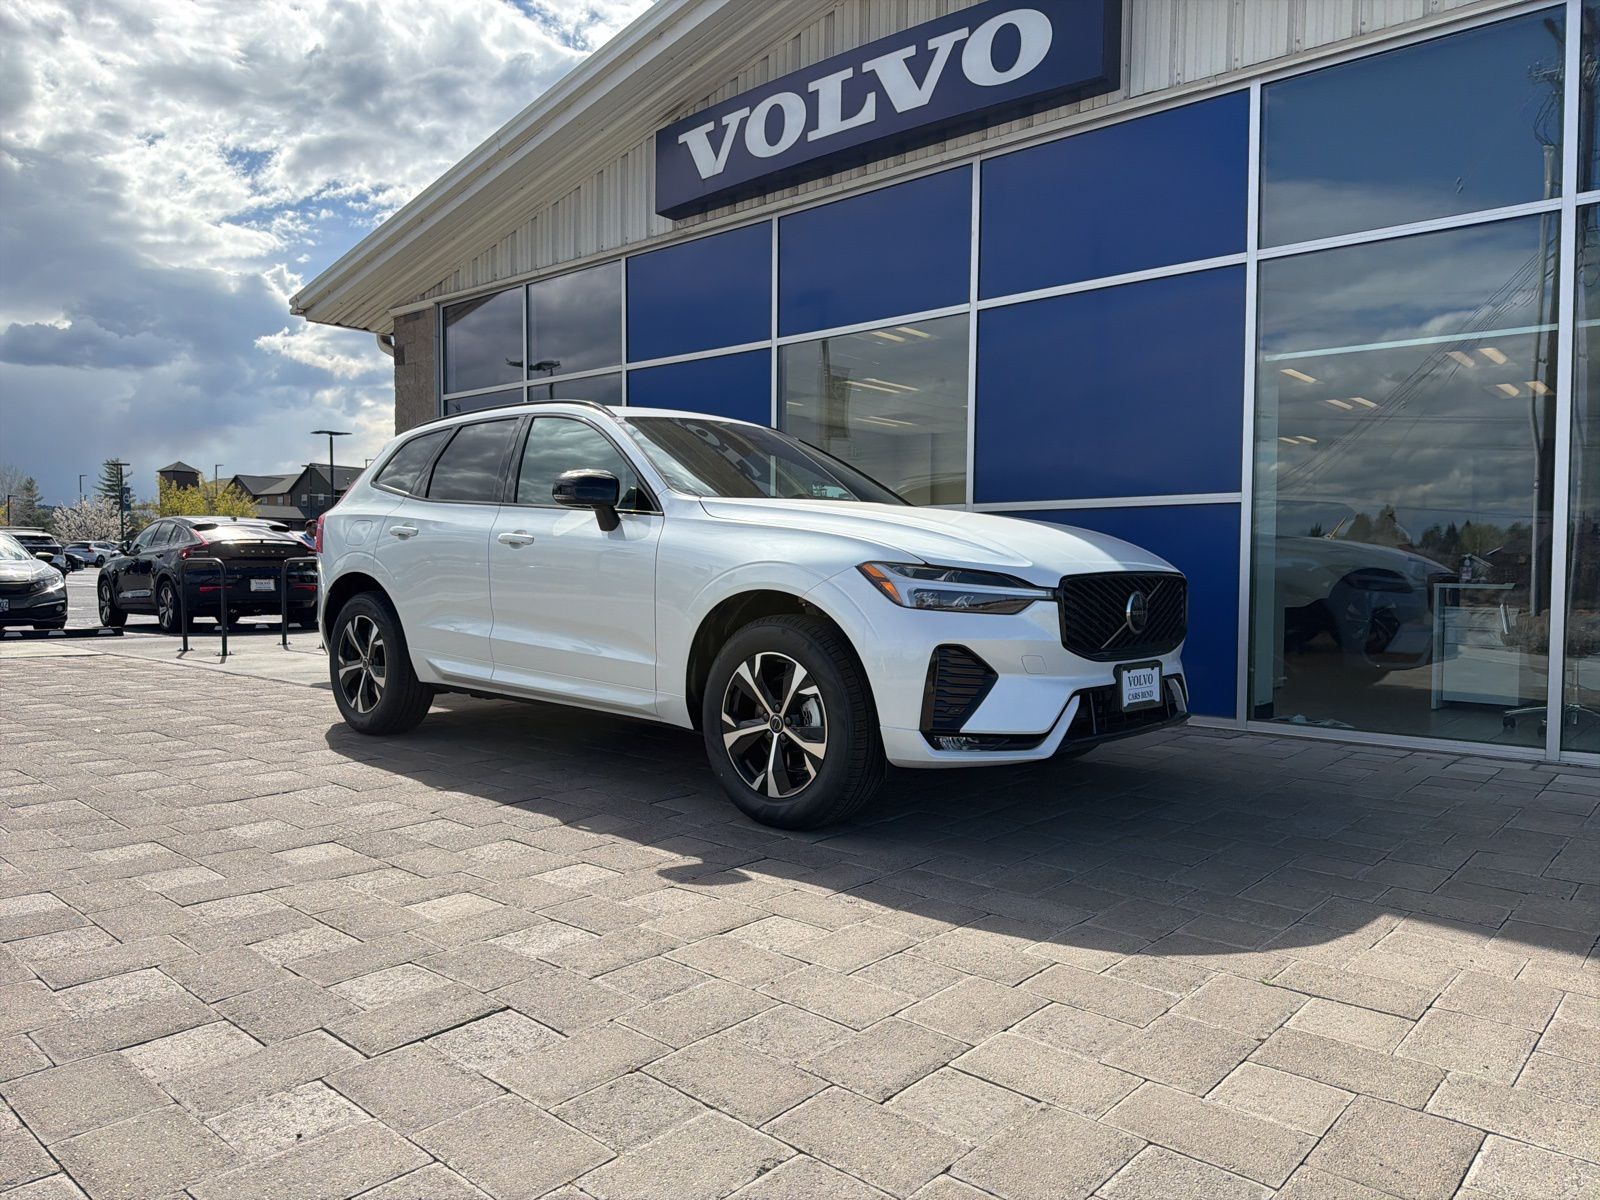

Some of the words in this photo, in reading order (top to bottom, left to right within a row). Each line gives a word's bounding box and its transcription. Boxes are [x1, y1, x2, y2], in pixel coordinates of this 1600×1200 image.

[678, 8, 1053, 180] VOLVO
[1128, 673, 1153, 687] VOLVO
[1128, 692, 1140, 701] CARS
